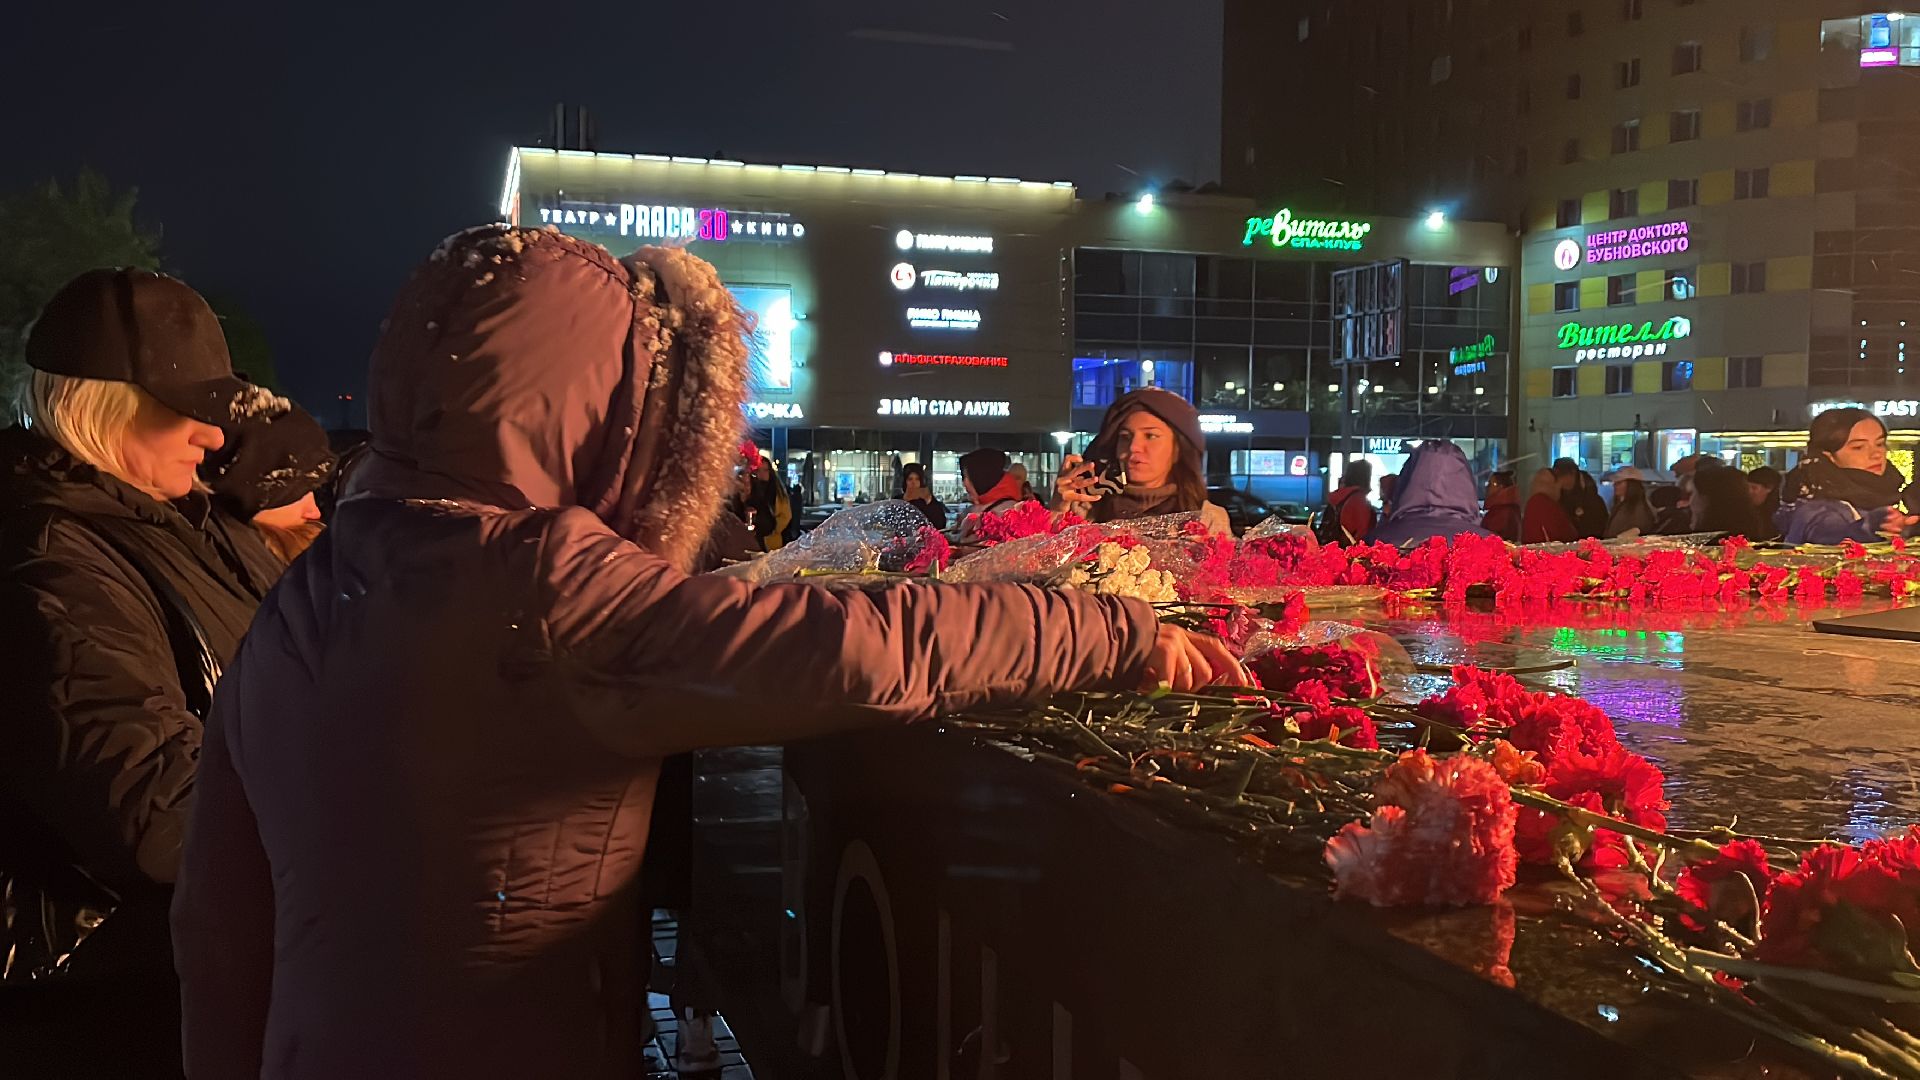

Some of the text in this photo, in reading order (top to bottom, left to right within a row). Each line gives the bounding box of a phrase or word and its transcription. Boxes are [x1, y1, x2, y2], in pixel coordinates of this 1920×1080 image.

[540, 208, 600, 225] ТЕАТР
[699, 209, 728, 241] 3D
[747, 221, 805, 237] КИНО
[1291, 237, 1361, 249] СПА-КЛУБ
[1587, 221, 1689, 248] ЦЕНТР ДОКТОРА
[1587, 237, 1689, 263] БУБНОВСКОГО
[894, 353, 1008, 367] АЛЬФАСТРАХОВАНИЕ
[1575, 343, 1667, 363] ресторан
[892, 397, 1010, 416] ВАЙТ СТАР ЛАУНЖ
[1874, 400, 1919, 416] EAST
[1370, 438, 1402, 451] MIUZ
